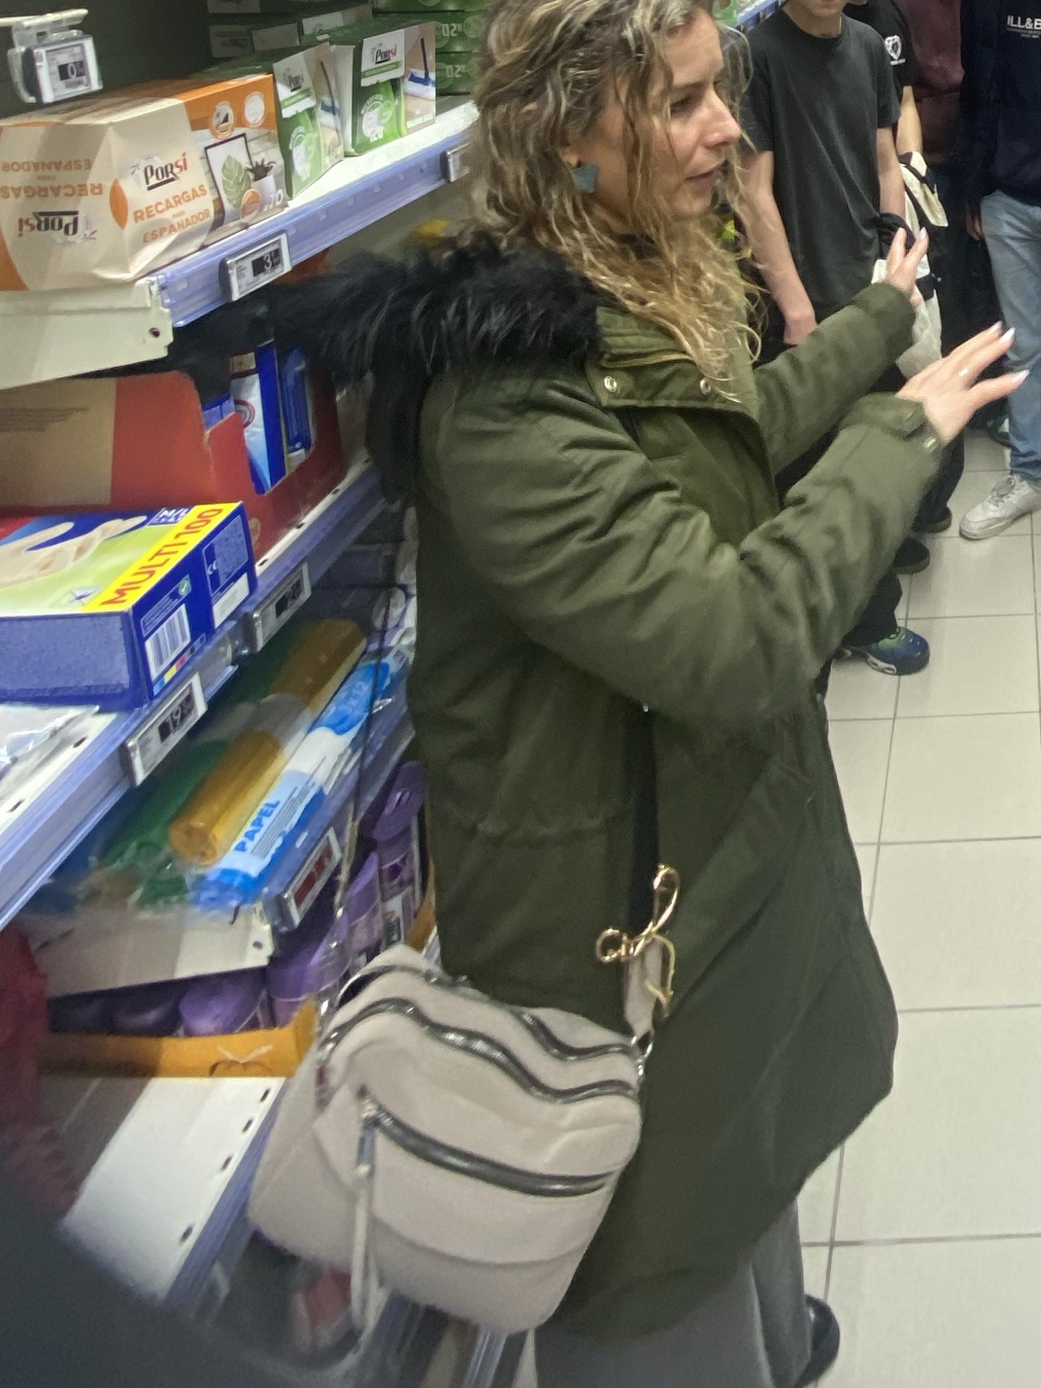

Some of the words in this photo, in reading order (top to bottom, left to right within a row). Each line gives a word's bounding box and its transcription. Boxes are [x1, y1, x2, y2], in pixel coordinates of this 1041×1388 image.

[375, 44, 398, 64] Porsi
[2, 159, 92, 173] ESPANADOR
[143, 152, 189, 189] Porsi
[1, 183, 104, 199] RECARGAS
[133, 184, 207, 224] RECARGAS
[18, 212, 79, 238] Porsi
[142, 208, 211, 245] ESPANADOR
[100, 542, 188, 606] MULTI
[174, 508, 224, 540] 100
[234, 800, 280, 853] PAPEL
